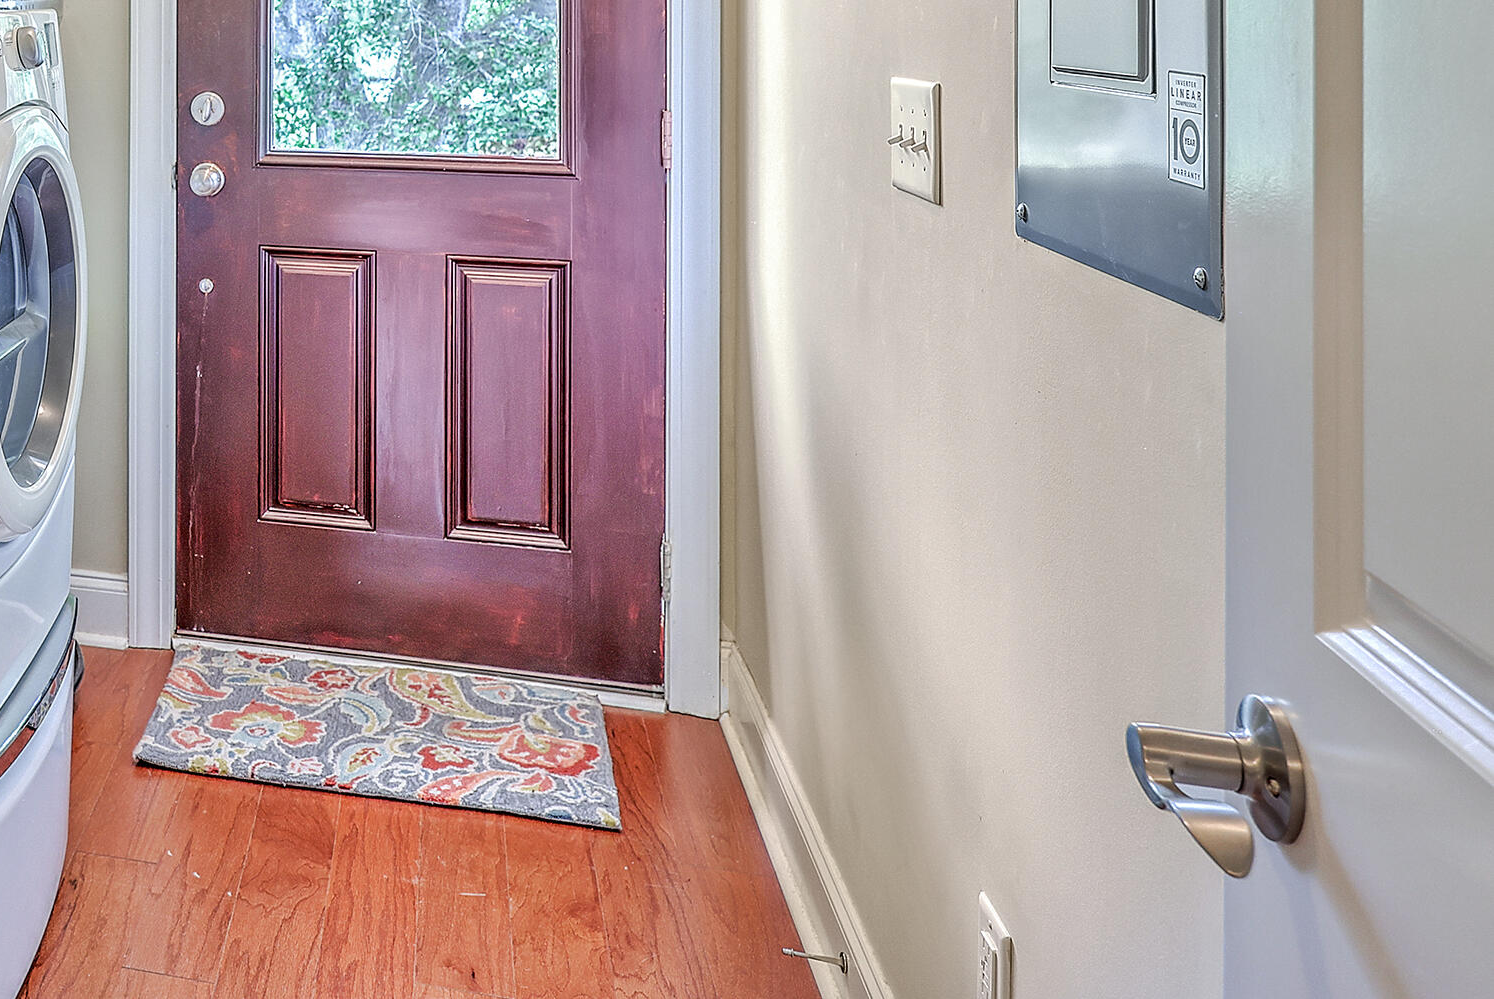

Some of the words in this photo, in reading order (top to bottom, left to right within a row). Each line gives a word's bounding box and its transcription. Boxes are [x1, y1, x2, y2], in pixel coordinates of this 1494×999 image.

[1175, 79, 1197, 88] INVERTER
[1170, 86, 1202, 102] LINEAR
[1172, 117, 1201, 165] 10
[1184, 136, 1196, 147] YEAR
[1172, 167, 1201, 181] WARRANTY
